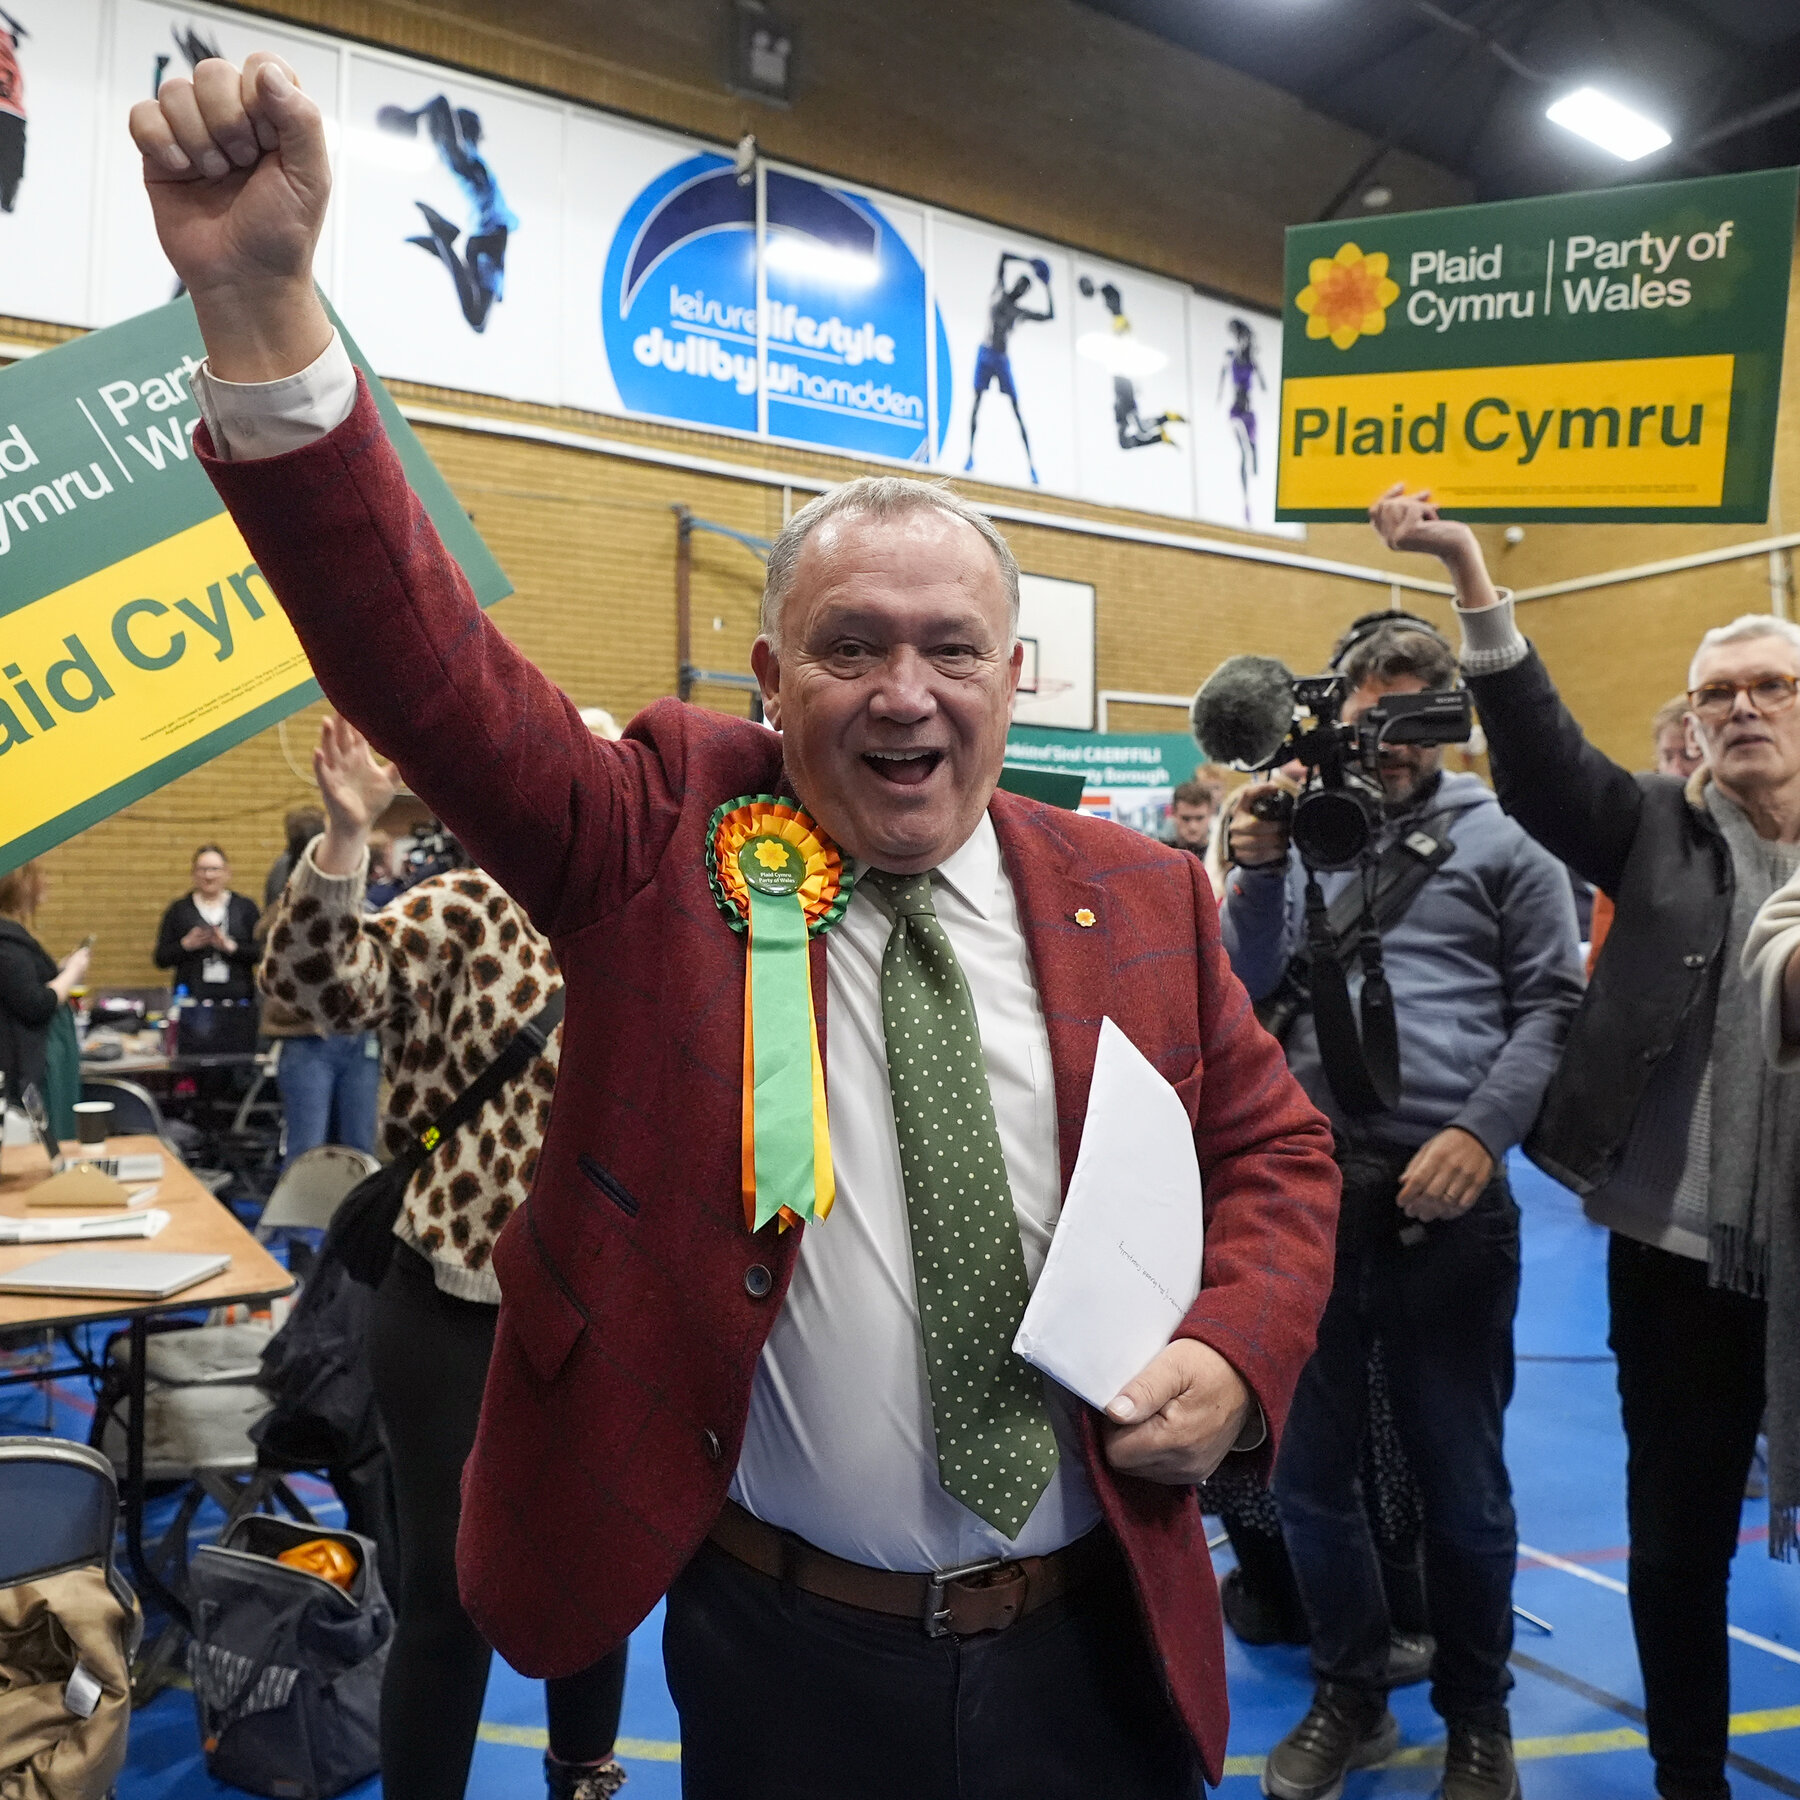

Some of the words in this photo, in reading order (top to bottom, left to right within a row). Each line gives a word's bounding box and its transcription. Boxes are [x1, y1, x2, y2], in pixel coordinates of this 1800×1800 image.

[1410, 244, 1502, 287] Plaid
[1565, 231, 1680, 274] Party
[1687, 220, 1734, 261] of
[1407, 289, 1535, 333] Cymru
[1562, 273, 1692, 314] Wales
[97, 354, 207, 427] Part
[1293, 403, 1447, 457] Plaid
[1464, 397, 1704, 466] Cymru
[0, 462, 114, 555] ymru
[0, 633, 116, 757] aid
